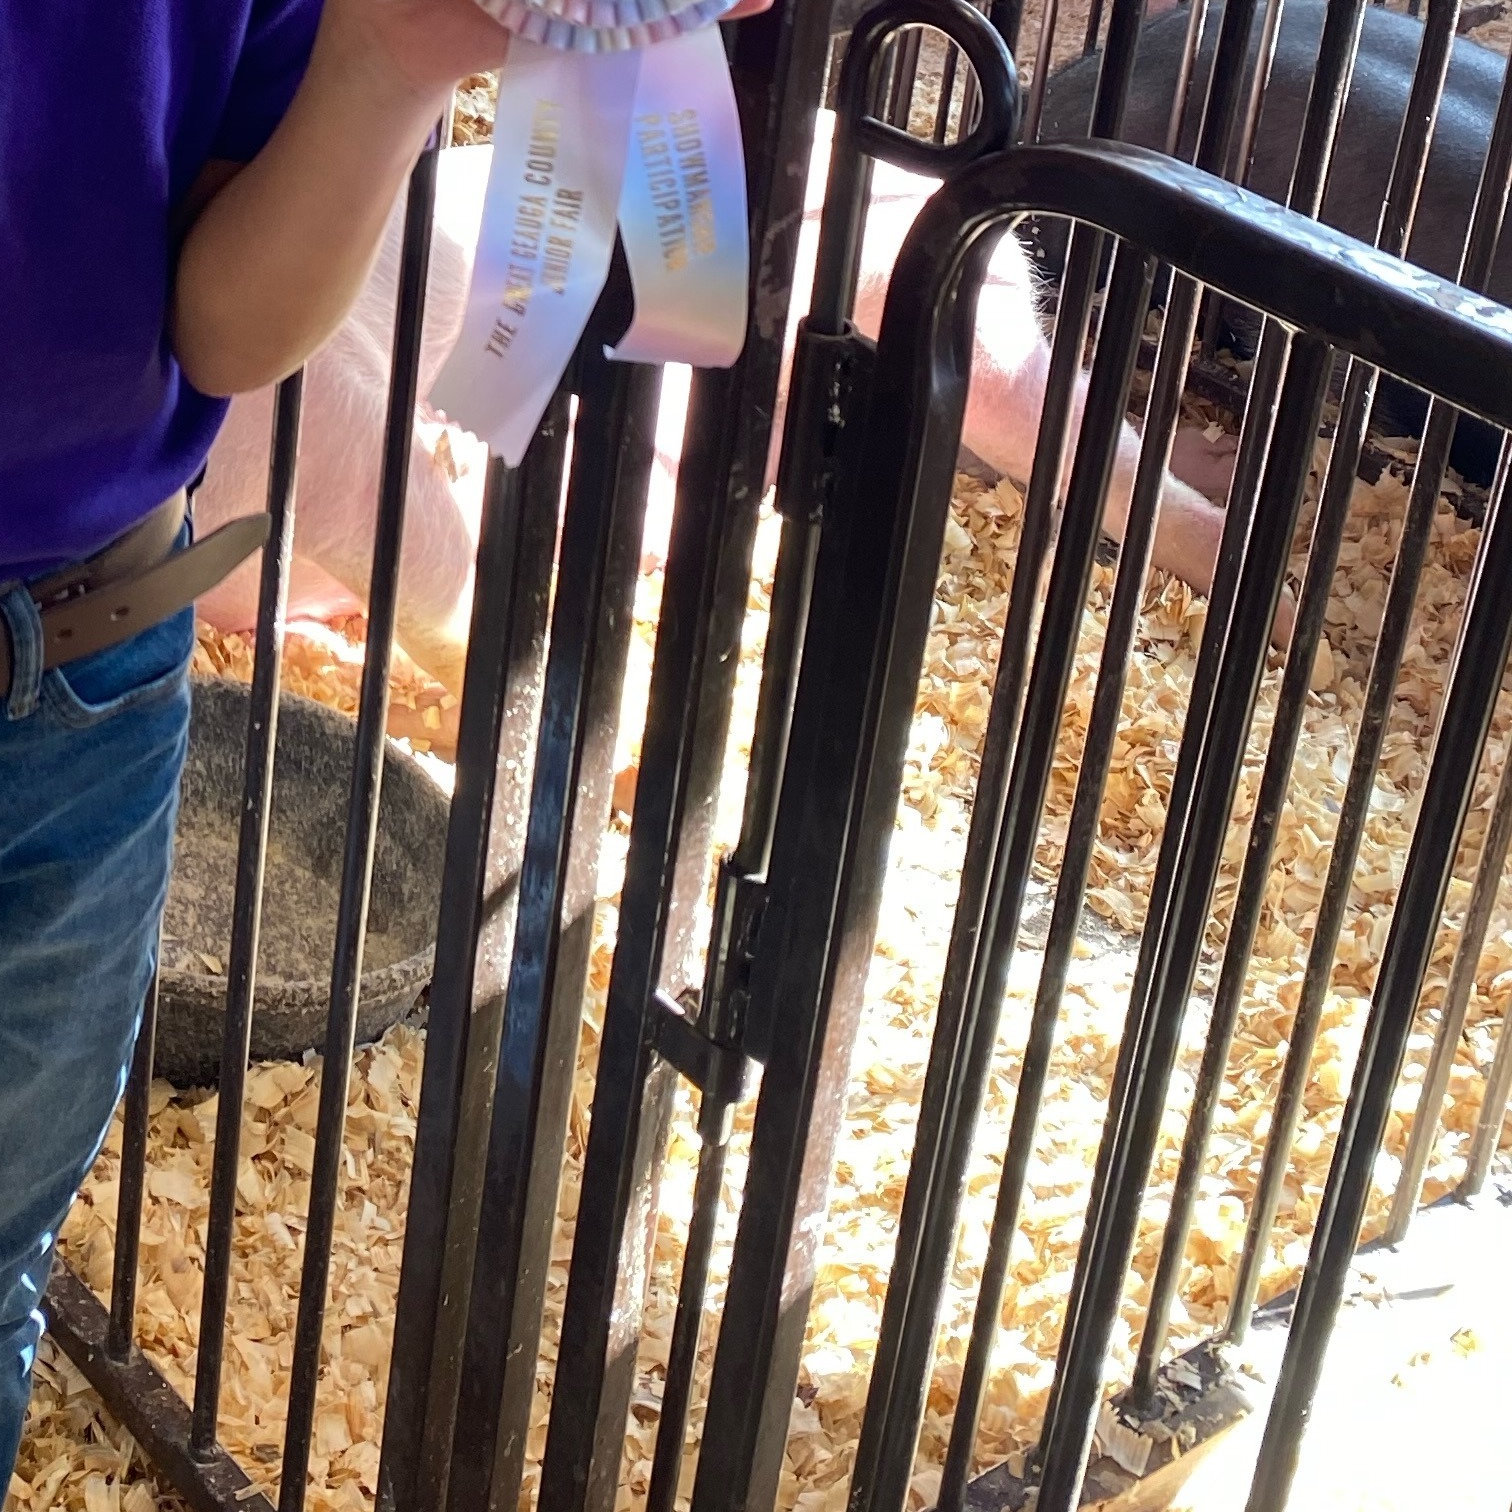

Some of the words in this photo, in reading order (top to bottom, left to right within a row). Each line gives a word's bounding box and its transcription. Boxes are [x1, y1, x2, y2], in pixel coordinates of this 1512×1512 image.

[551, 188, 584, 232] FAIR
[484, 316, 517, 359] THE
[511, 194, 548, 261] GEAUGA
